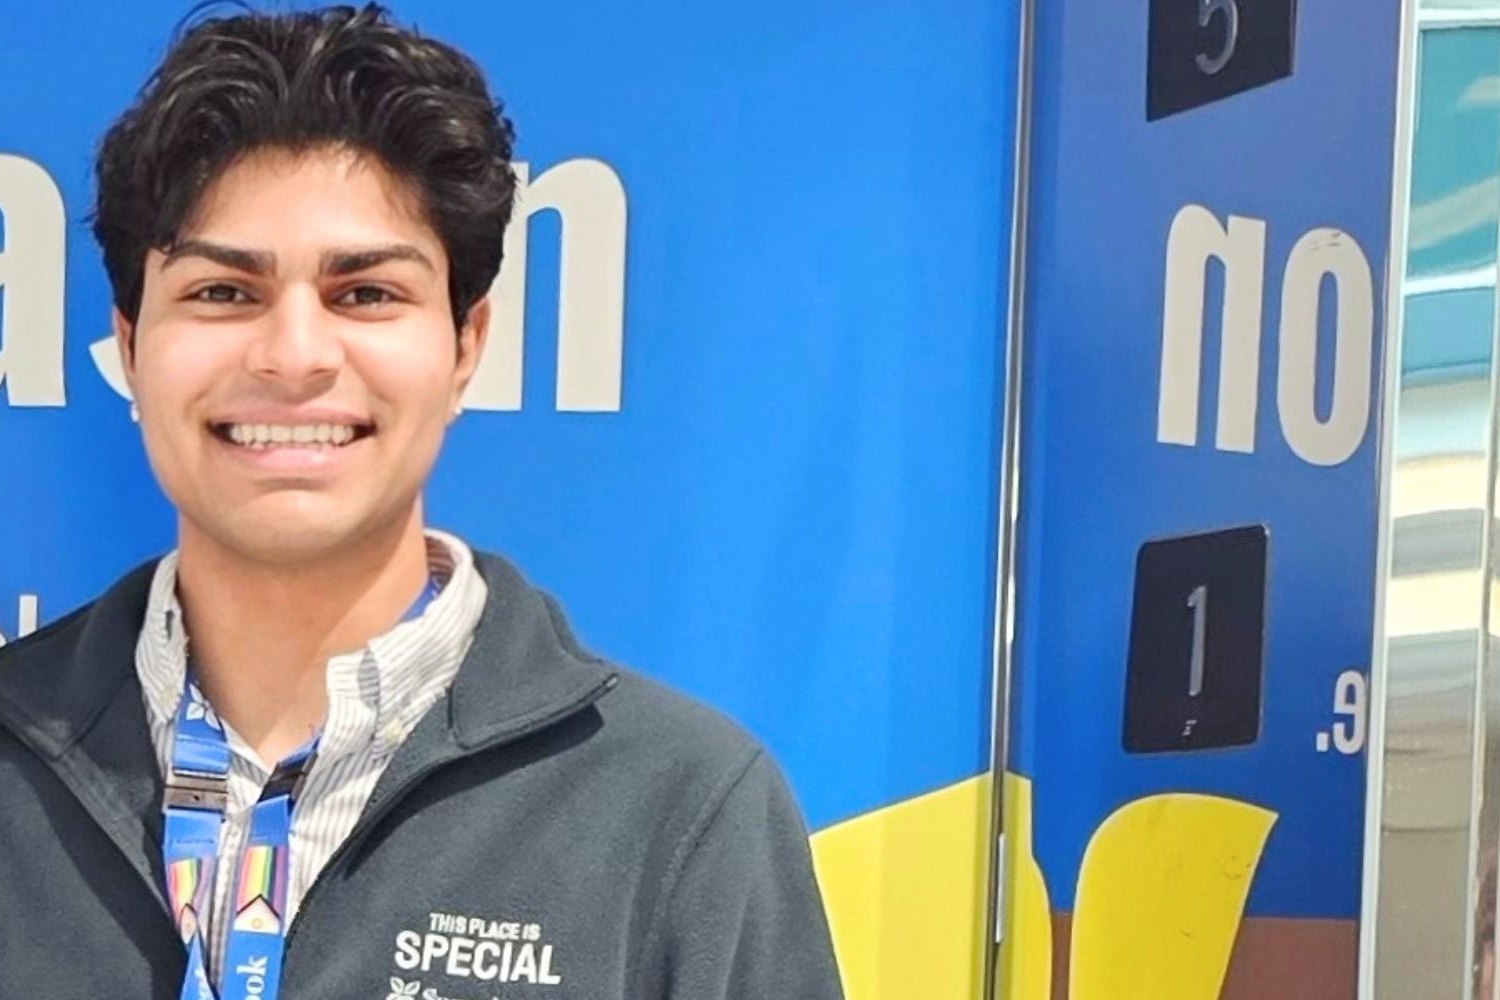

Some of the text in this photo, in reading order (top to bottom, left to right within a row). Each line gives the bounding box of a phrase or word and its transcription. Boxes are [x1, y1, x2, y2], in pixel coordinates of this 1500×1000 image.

[1187, 584, 1208, 697] 1
[429, 912, 542, 942] THIS PLACE IS
[394, 929, 562, 986] SPECIAL
